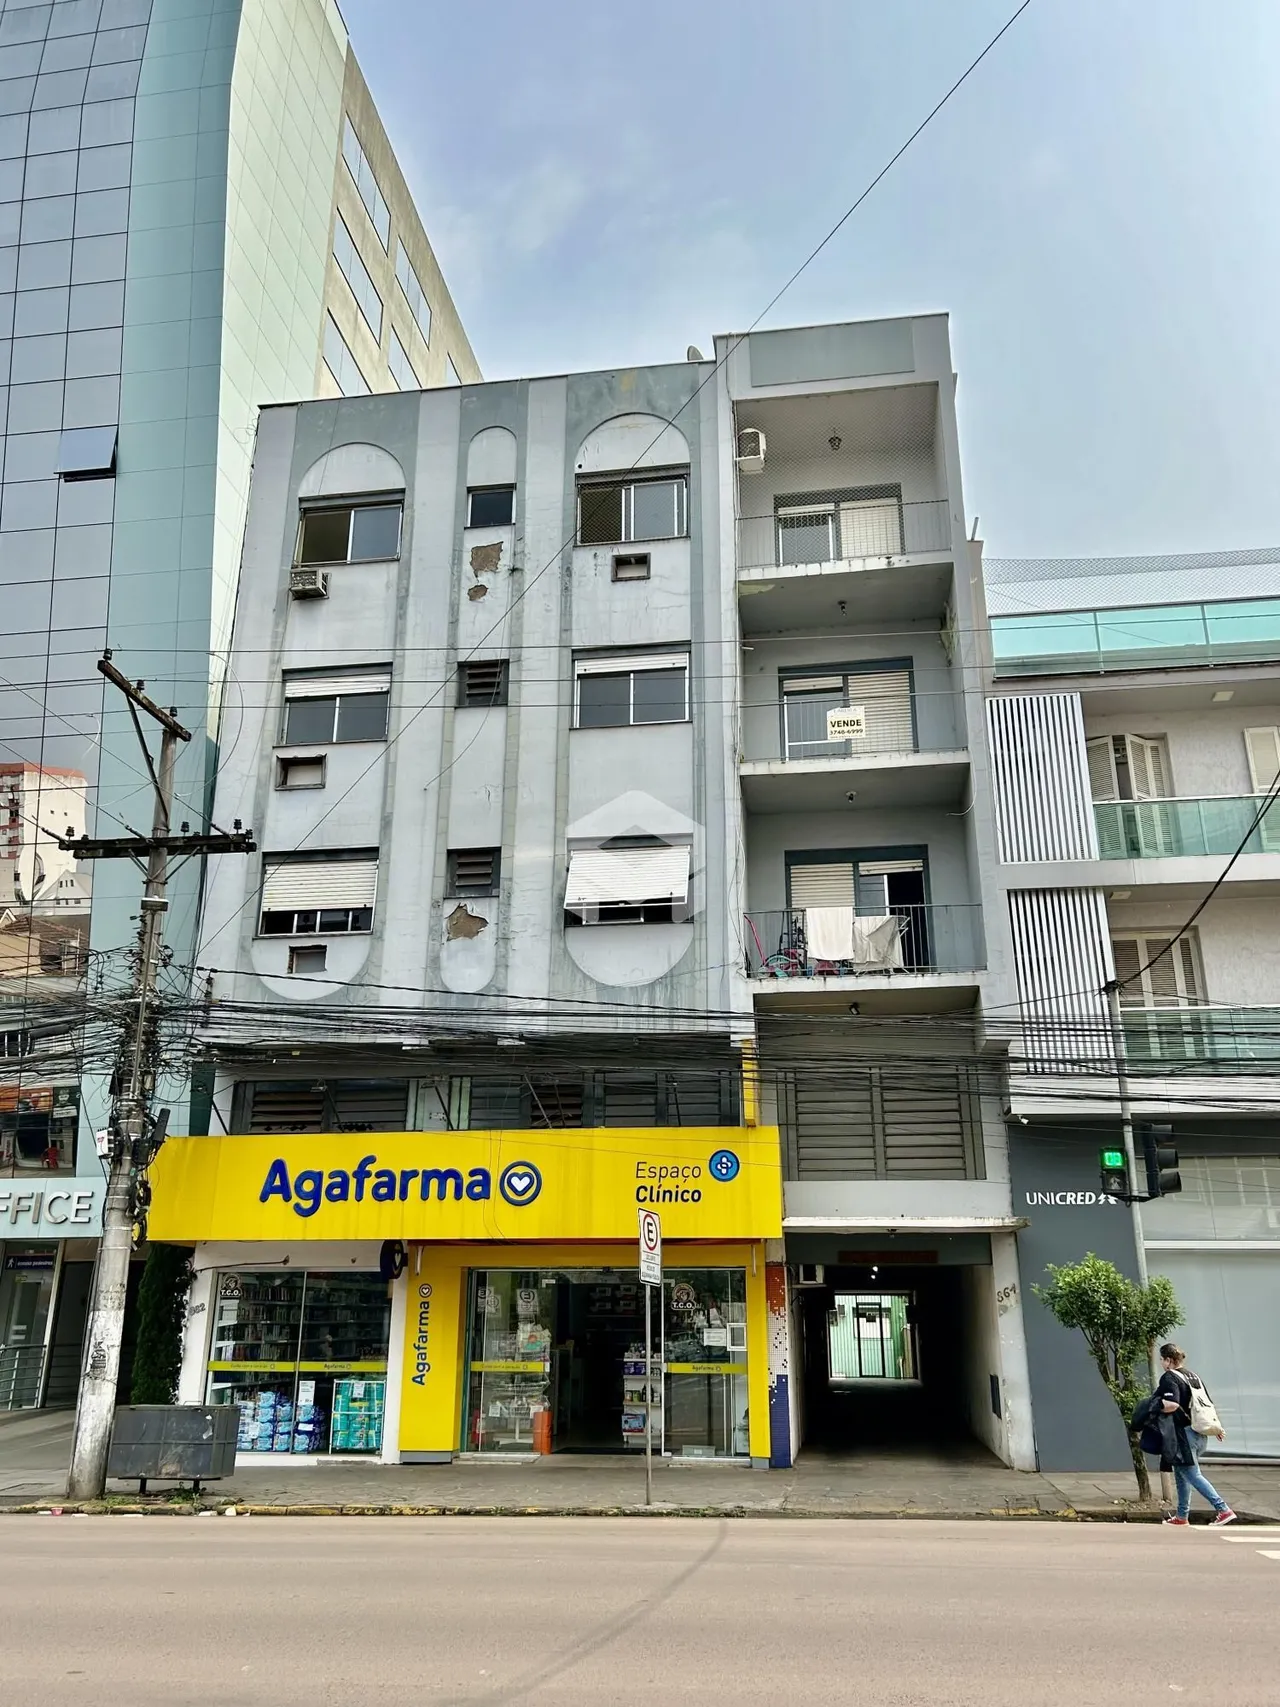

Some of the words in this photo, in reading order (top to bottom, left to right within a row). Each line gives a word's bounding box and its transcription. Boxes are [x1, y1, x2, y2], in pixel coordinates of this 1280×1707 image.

[830, 719, 862, 728] VENDE
[635, 1161, 702, 1183] Espaço
[259, 1155, 492, 1218] Agafarma
[635, 1183, 702, 1203] Clínico
[1025, 1192, 1096, 1205] UNICRED
[646, 1221, 654, 1243] E
[412, 1300, 431, 1386] Agafarma
